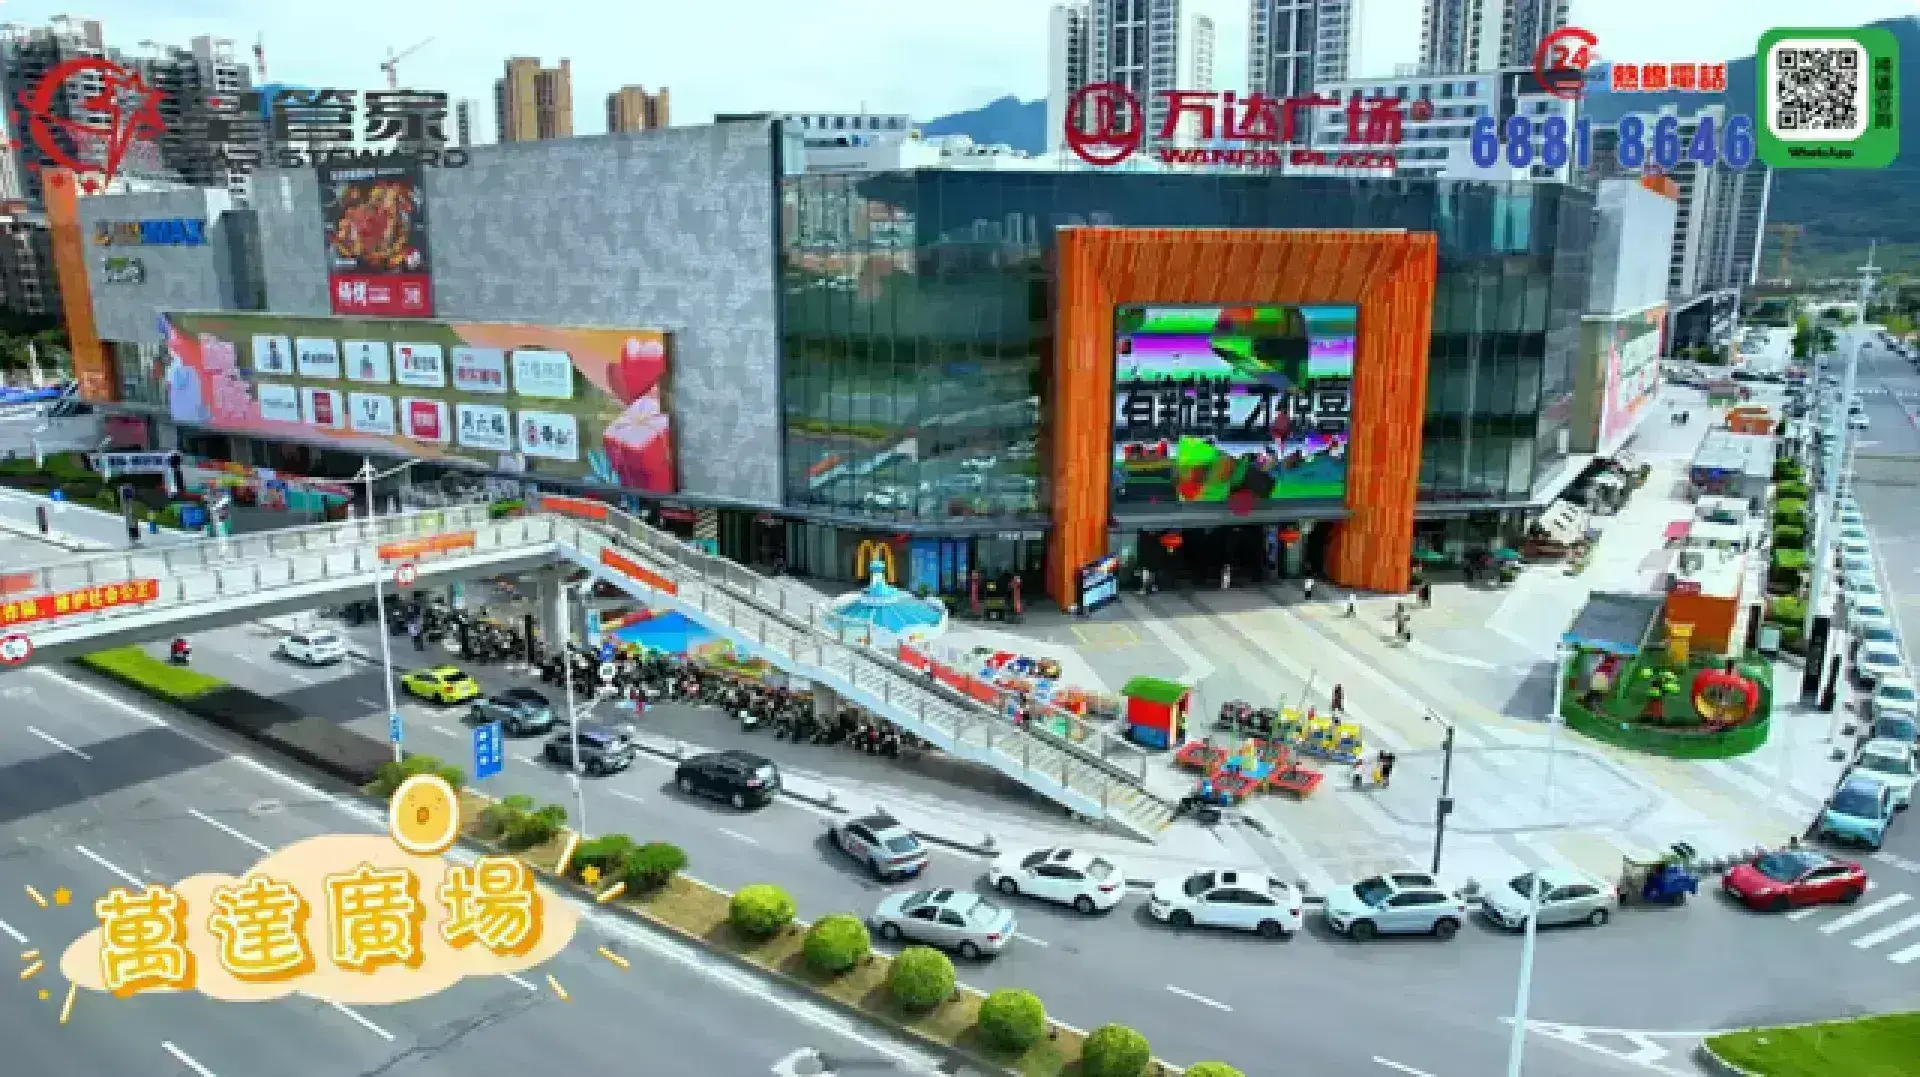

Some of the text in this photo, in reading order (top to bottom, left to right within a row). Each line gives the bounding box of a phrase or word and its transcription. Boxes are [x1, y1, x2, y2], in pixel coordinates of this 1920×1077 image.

[1159, 89, 1404, 145] 万达广场
[1159, 149, 1397, 169] WANDA PLAZA
